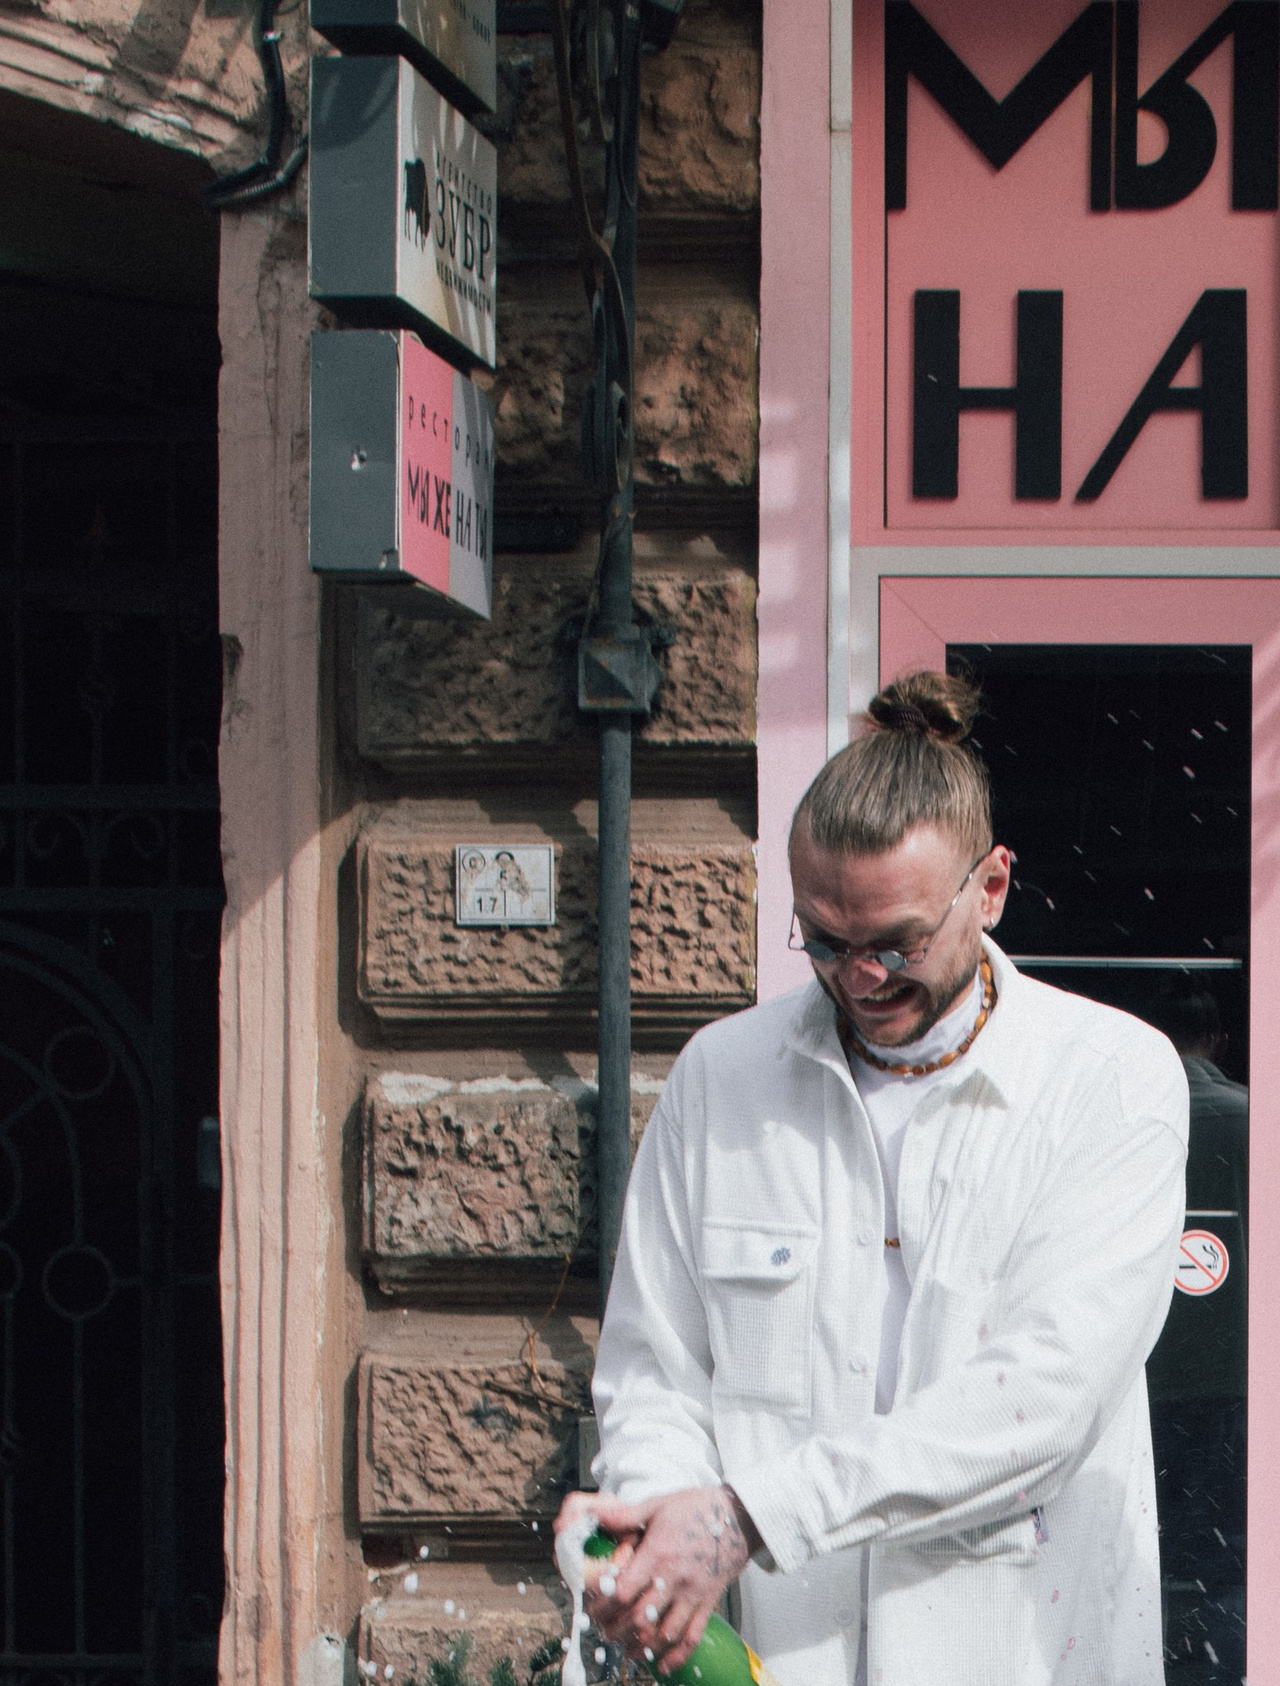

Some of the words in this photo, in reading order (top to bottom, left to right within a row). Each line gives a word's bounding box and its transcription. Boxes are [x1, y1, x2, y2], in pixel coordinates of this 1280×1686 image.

[885, 0, 1280, 213] МЫ
[435, 176, 491, 282] ЗУБР
[912, 289, 1249, 500] НА
[407, 459, 430, 527] МЫ
[433, 474, 451, 539] ЖЕ
[455, 489, 472, 552] НА
[475, 502, 488, 563] ТЫ
